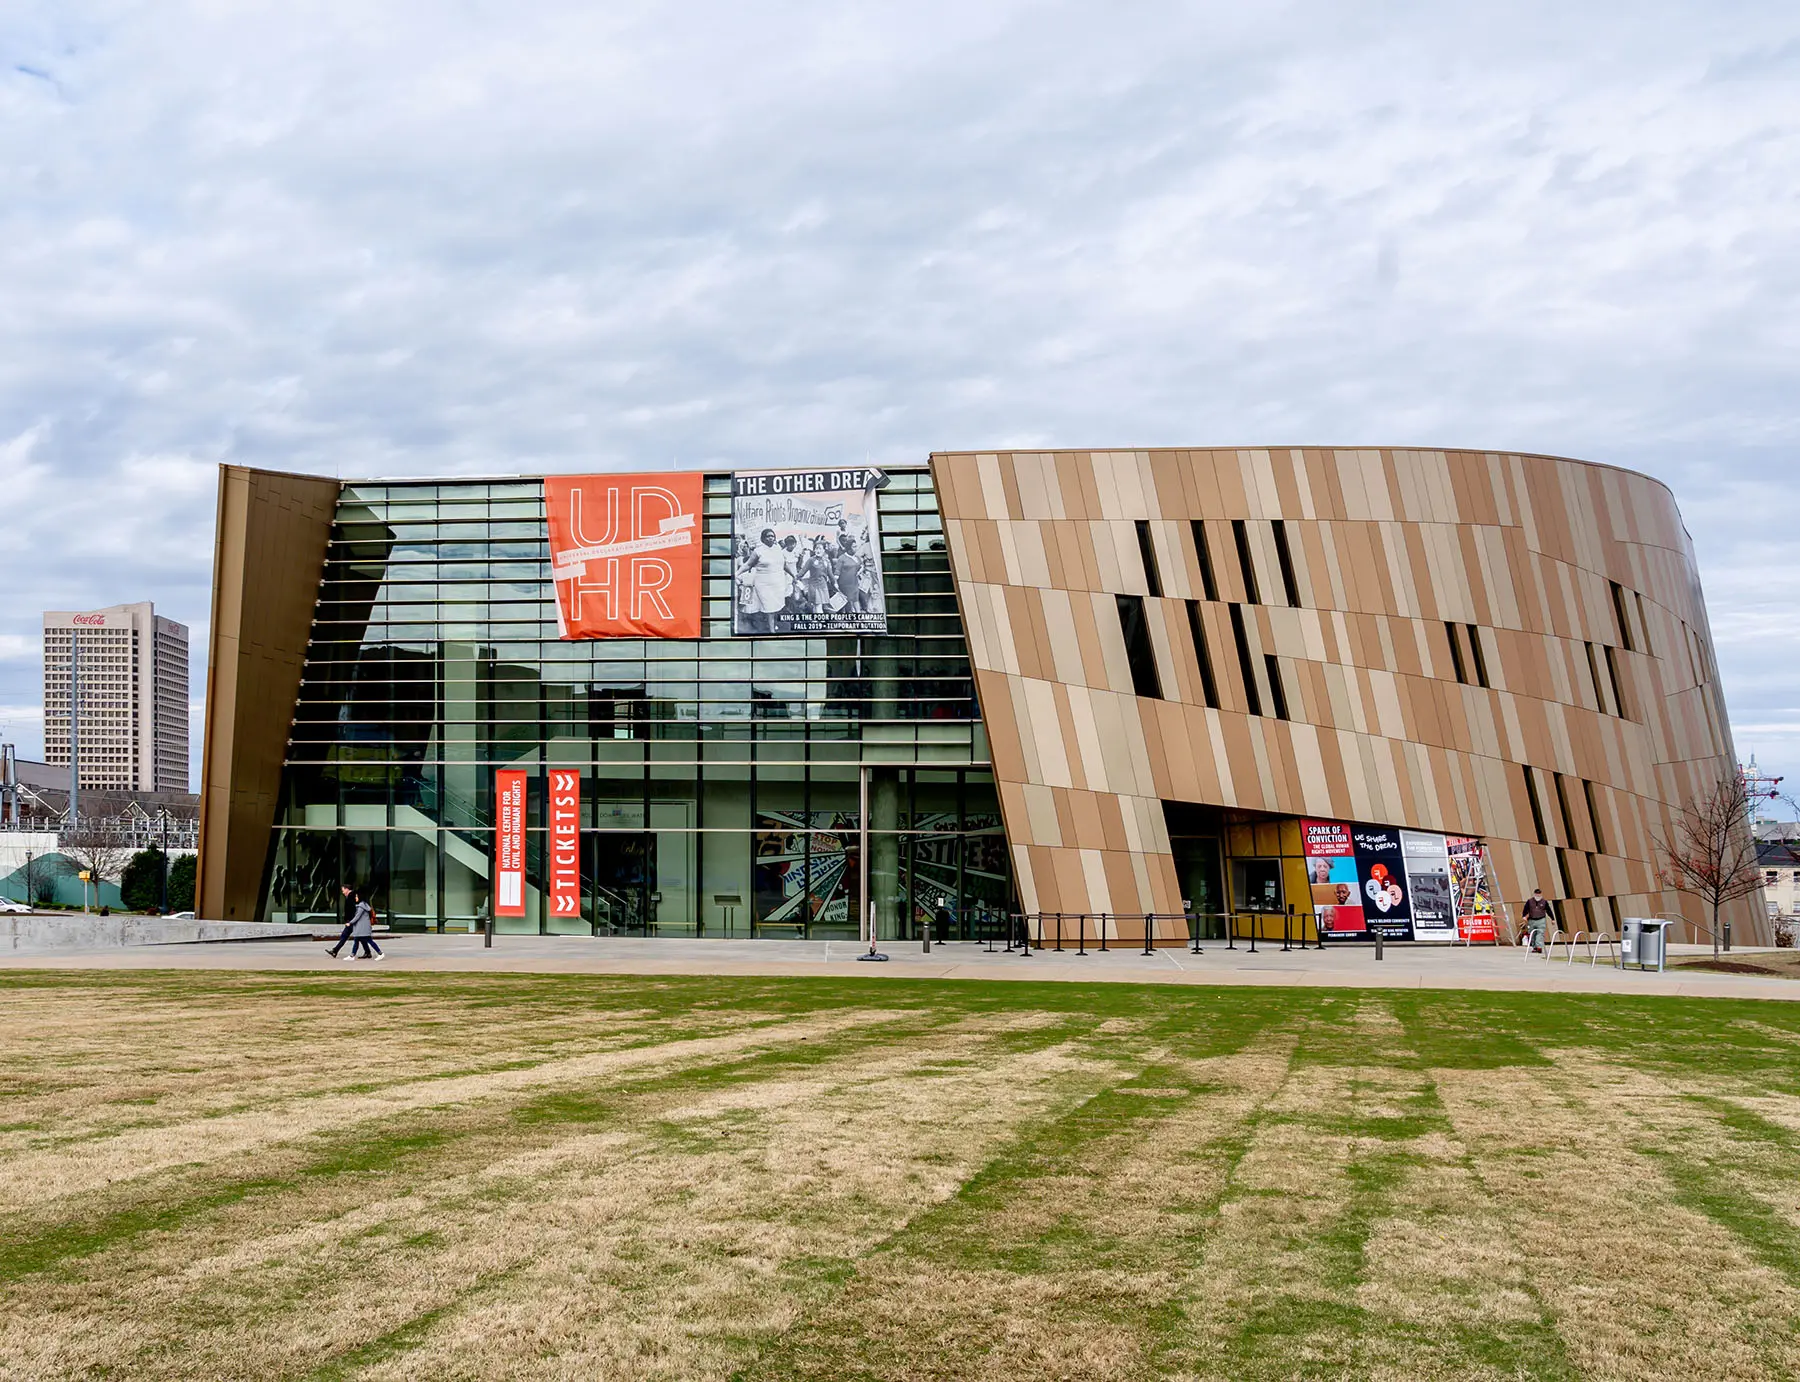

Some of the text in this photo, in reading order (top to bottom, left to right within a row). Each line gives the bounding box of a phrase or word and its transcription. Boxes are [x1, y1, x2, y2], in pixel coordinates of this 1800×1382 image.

[737, 471, 873, 495] THE OTHER DREA
[801, 613, 812, 621] THE
[813, 613, 829, 621] POOR
[830, 613, 857, 621] PEOPLE'S
[857, 613, 886, 621] CAMPAIG
[793, 622, 807, 630] FALL
[808, 622, 823, 630] 2019
[826, 622, 860, 630] TEMPORARY
[512, 780, 521, 869] CIVIL AND HUMAN RIGHTS
[502, 791, 512, 869] NATIONAL CENTER FOR
[1308, 825, 1341, 835] SPARK OF
[556, 796, 576, 890] TICKETS
[1307, 834, 1348, 844] CONVICTION
[1366, 834, 1388, 843] SHARE
[1375, 842, 1398, 851] DREAM
